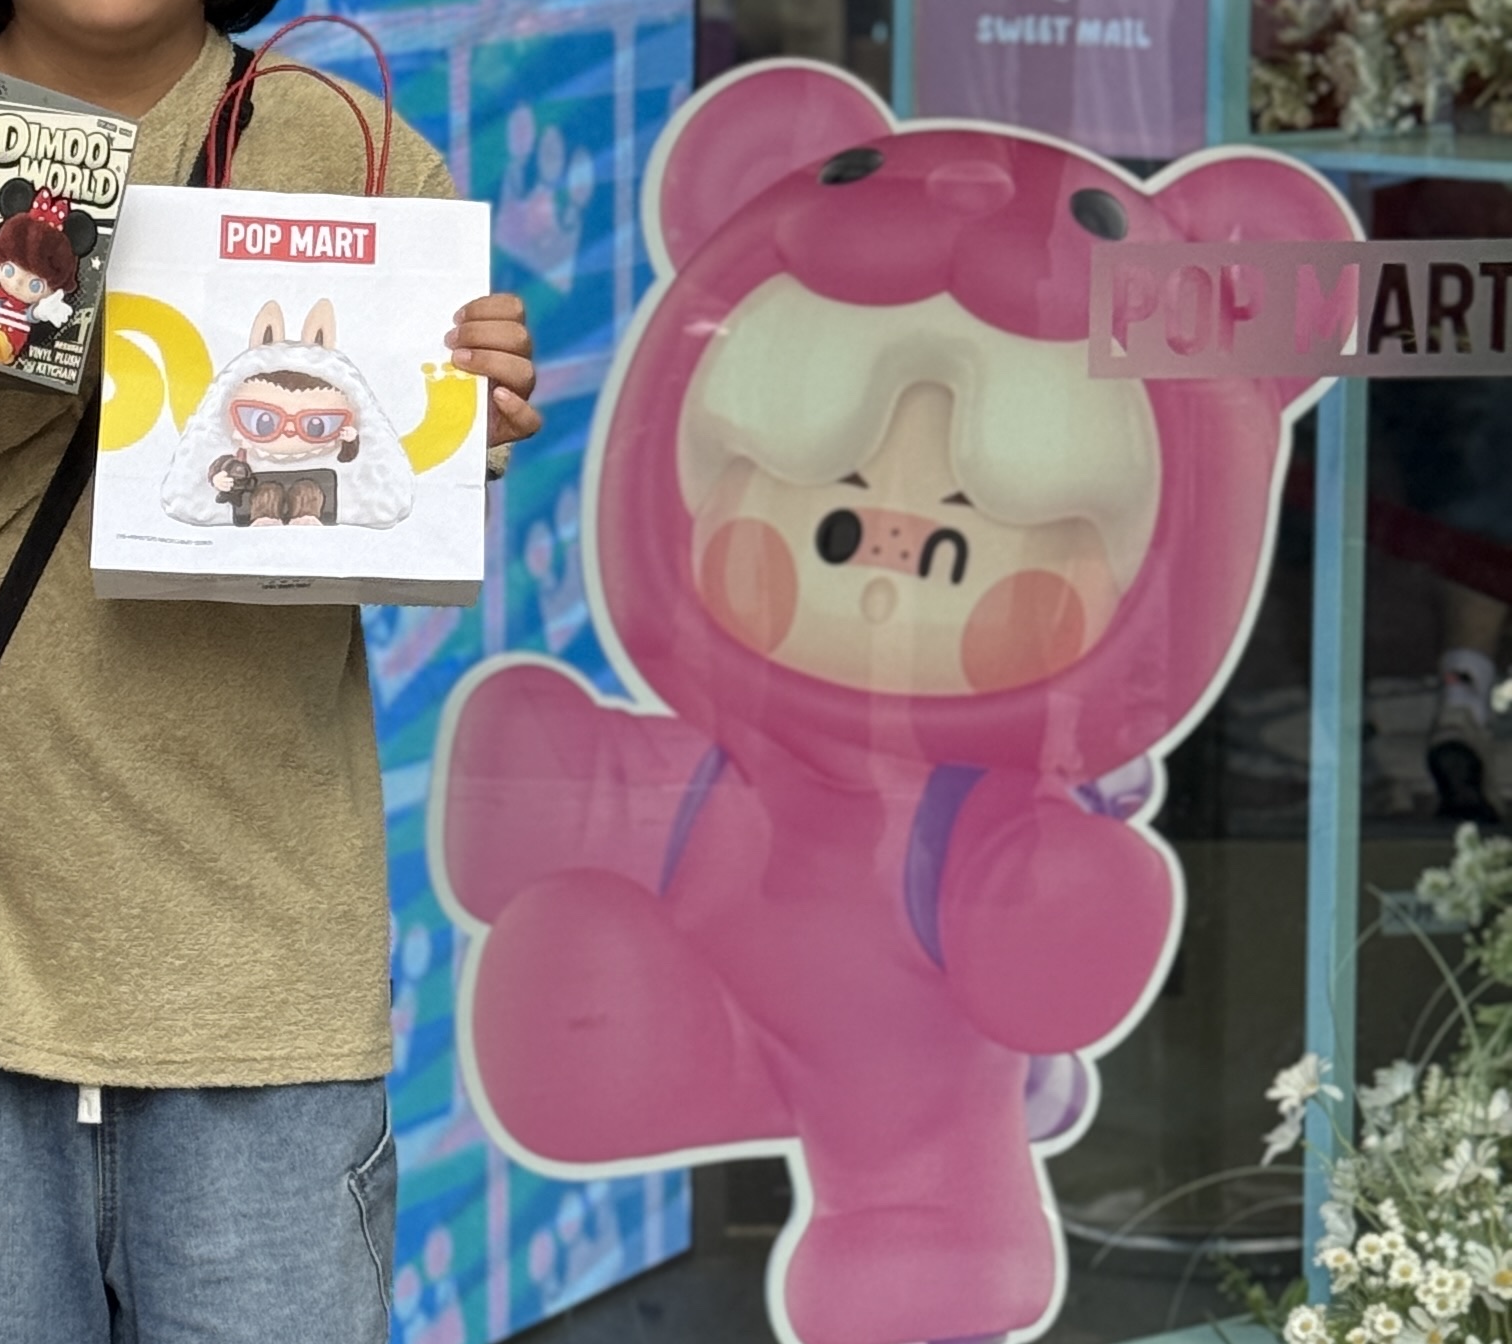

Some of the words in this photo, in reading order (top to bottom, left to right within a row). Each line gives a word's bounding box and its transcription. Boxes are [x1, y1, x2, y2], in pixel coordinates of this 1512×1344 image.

[976, 14, 1072, 46] SWEET
[1075, 17, 1153, 49] MAIL
[18, 156, 119, 209] WORLD
[227, 221, 282, 254] POP
[290, 225, 369, 258] MART
[1110, 262, 1265, 356] POP
[1295, 261, 1512, 356] MART
